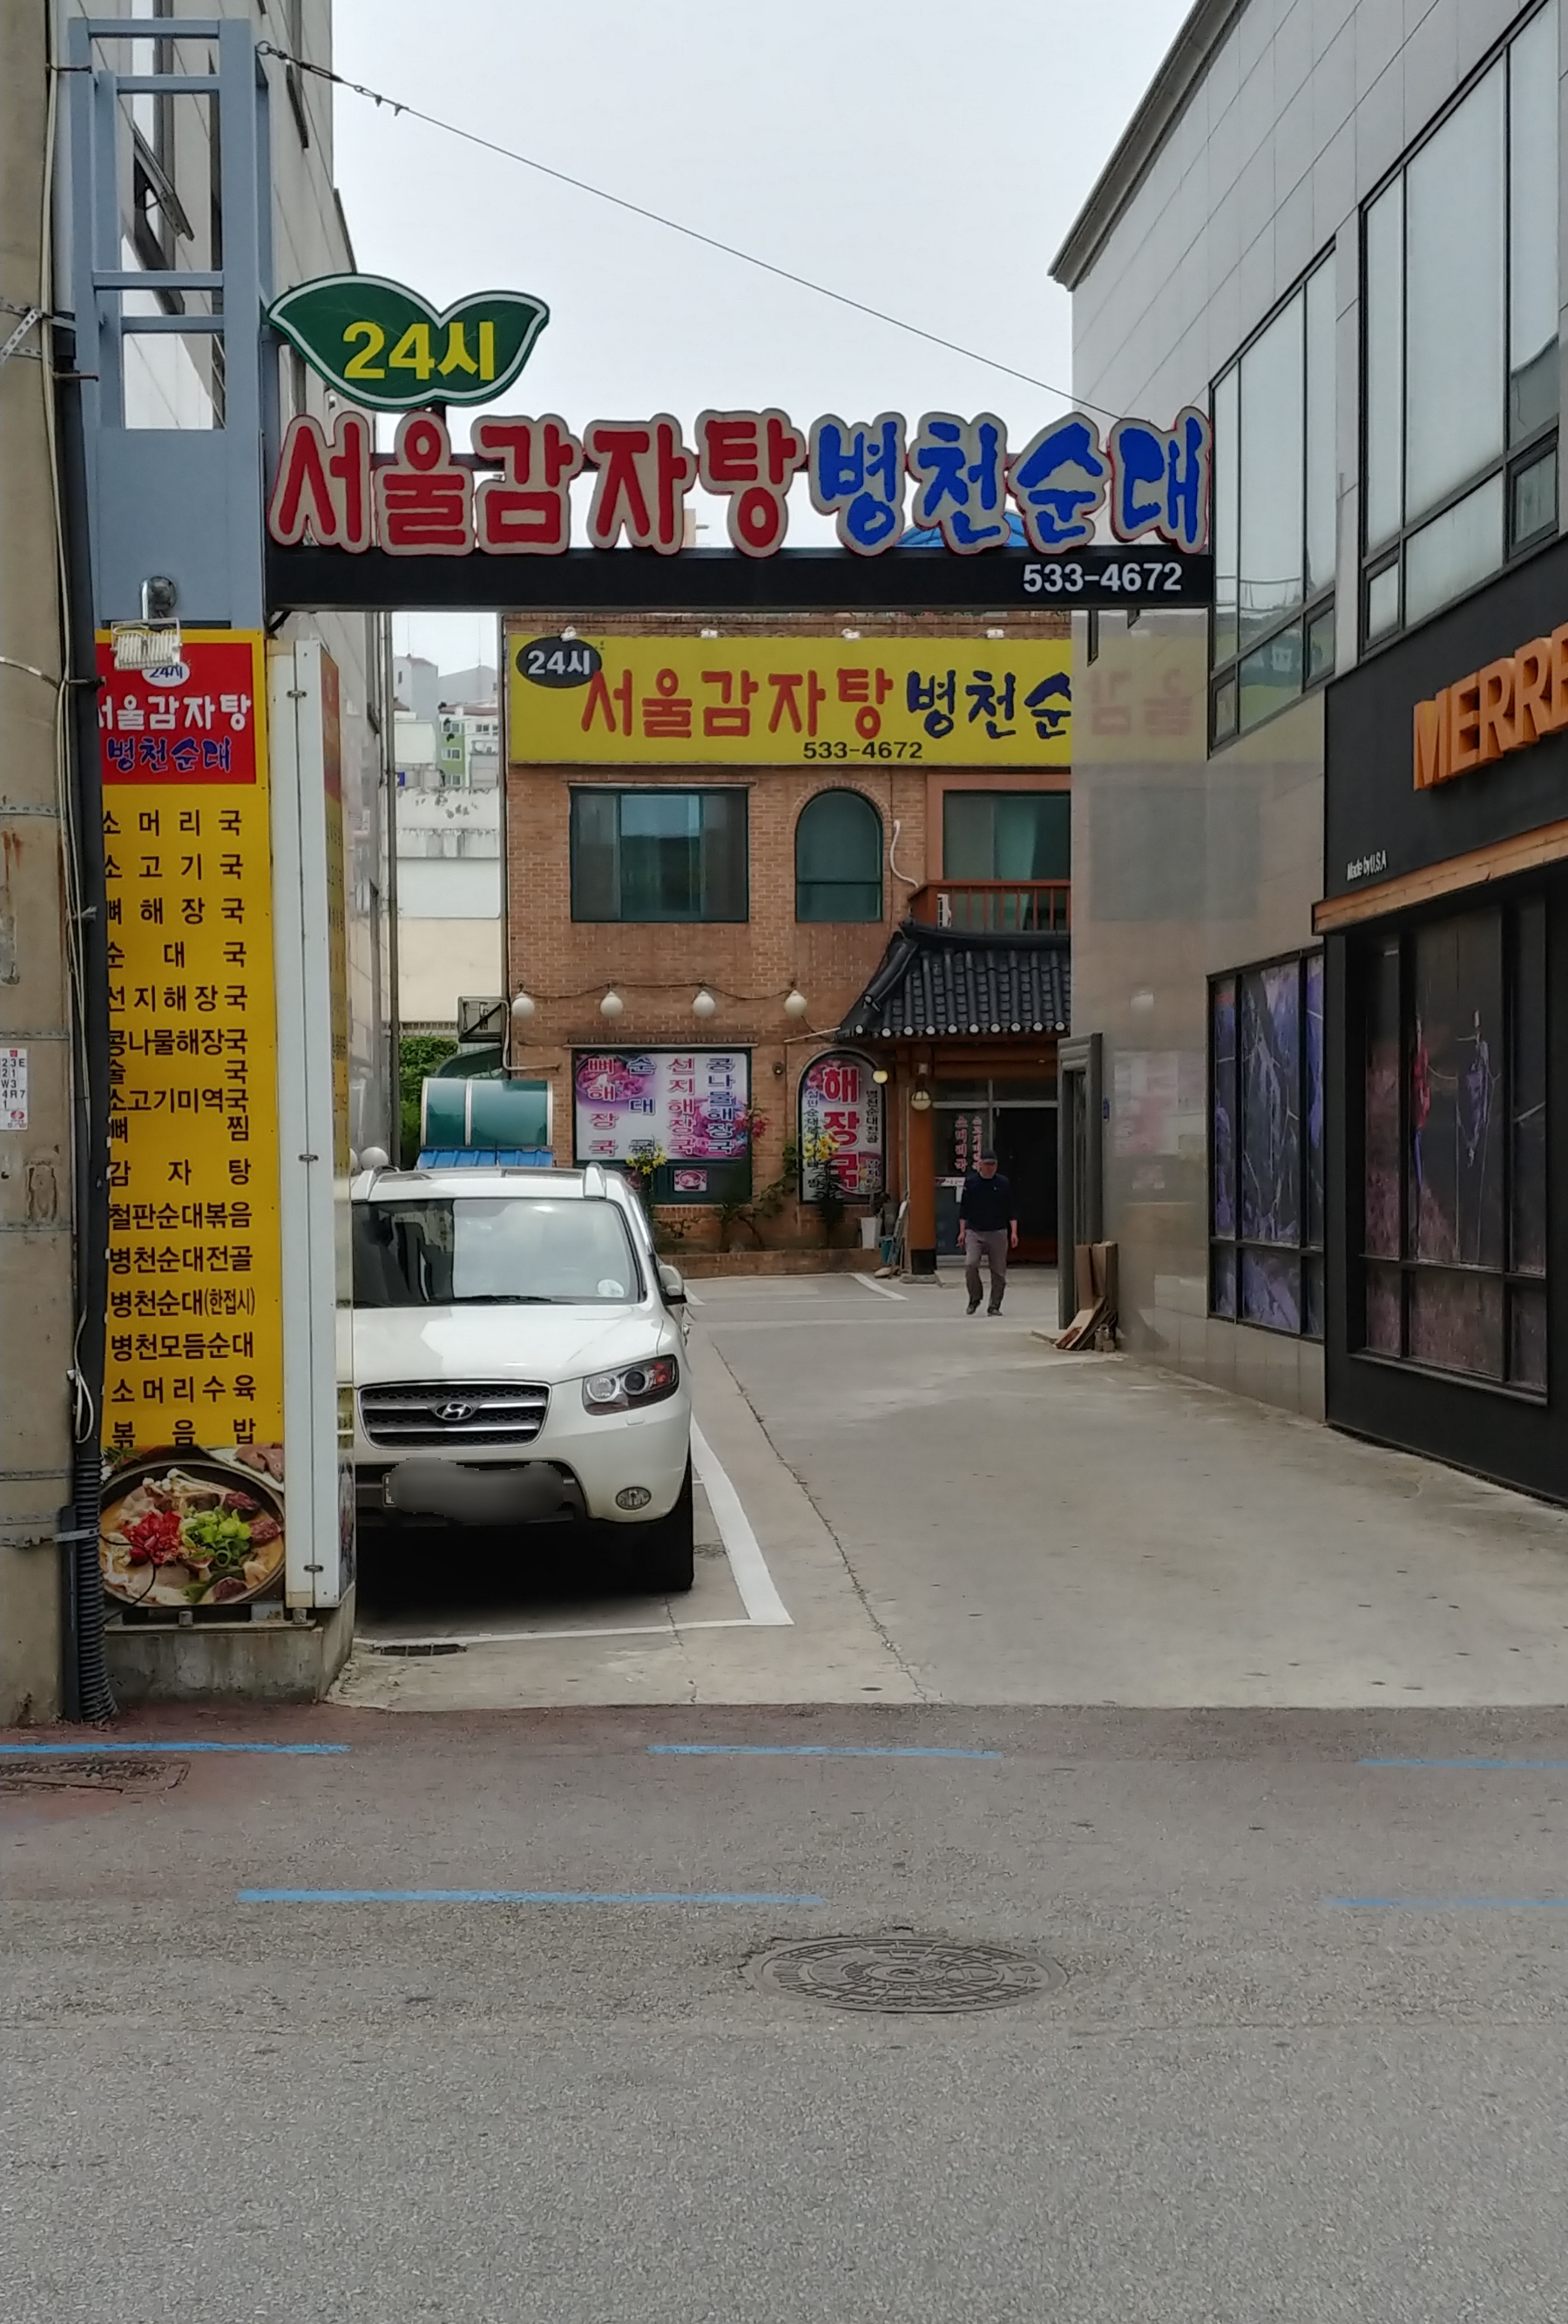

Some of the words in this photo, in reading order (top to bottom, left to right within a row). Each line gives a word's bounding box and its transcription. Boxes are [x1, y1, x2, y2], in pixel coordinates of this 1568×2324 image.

[343, 321, 496, 381] 24시
[272, 414, 802, 555] 서울감자탕
[814, 410, 1207, 551] 병천순대
[1023, 562, 1183, 593] 533-4672
[527, 649, 591, 676] 24시
[580, 667, 894, 740] 서울감자탕
[107, 736, 232, 773] 병천순대
[802, 740, 923, 760] 533-4672
[110, 1028, 248, 1057] 콩나물해장국
[110, 1088, 249, 1113] 소고기미역국
[587, 1057, 618, 1156] 뼈해장국
[666, 1057, 696, 1155] 선지해장국
[706, 1057, 735, 1155] 콩나물해장국
[823, 1068, 861, 1190] 해장국
[110, 1202, 253, 1231] 철판순대볶음
[110, 1246, 253, 1274] 병천순대전골
[111, 1331, 254, 1362] 병천모듬순대
